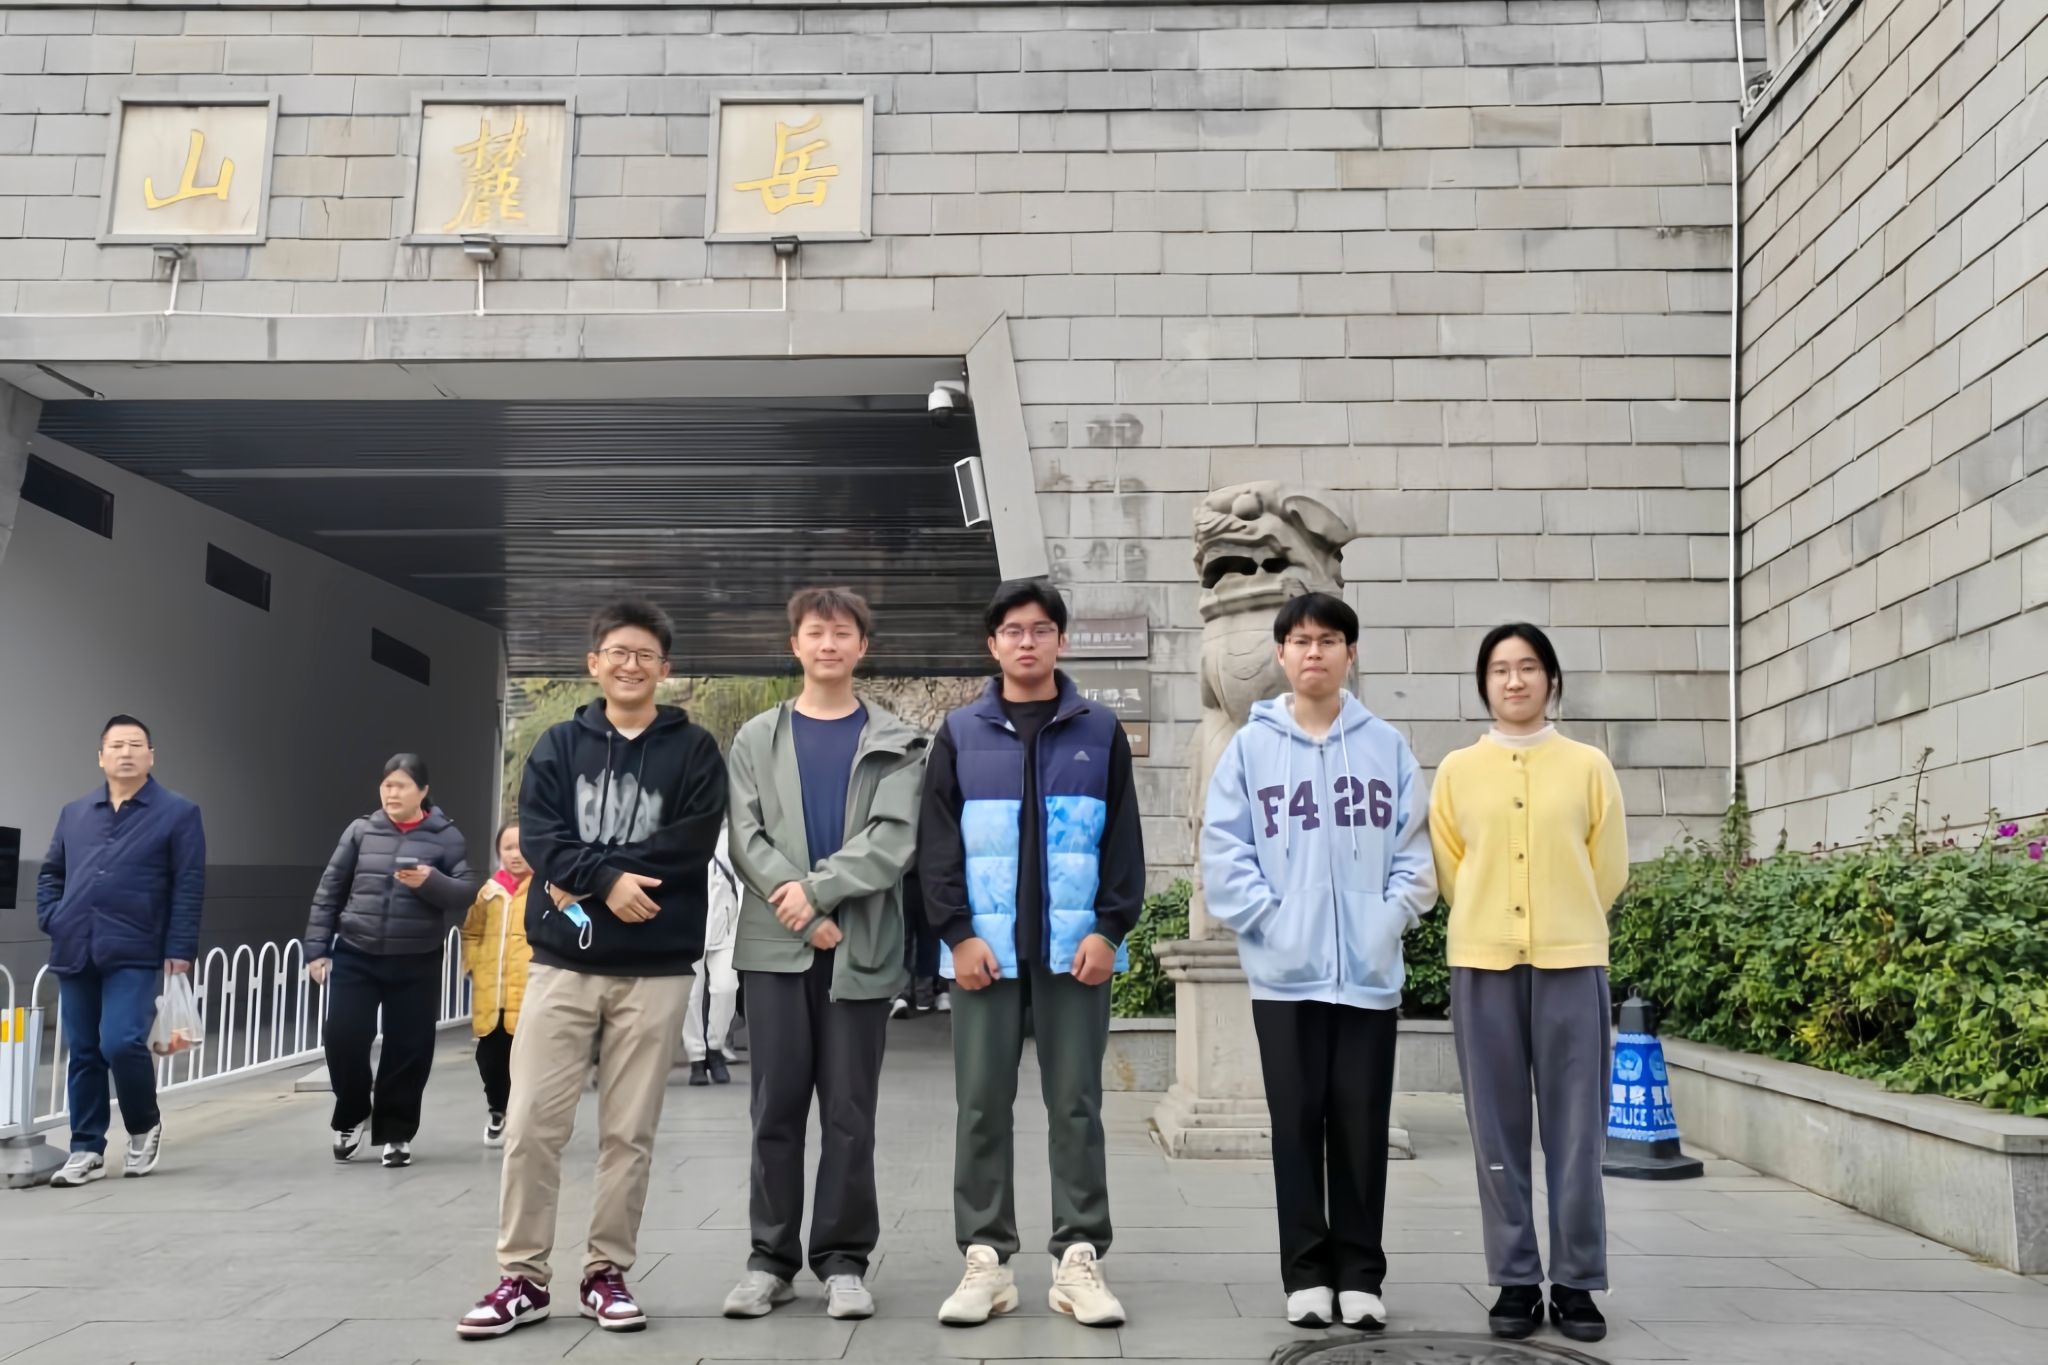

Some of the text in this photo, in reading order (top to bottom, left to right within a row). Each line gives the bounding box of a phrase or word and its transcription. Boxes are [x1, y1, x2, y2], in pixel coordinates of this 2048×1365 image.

[144, 108, 839, 233] 岳 麓 山
[1608, 1105, 1647, 1127] POLICE
